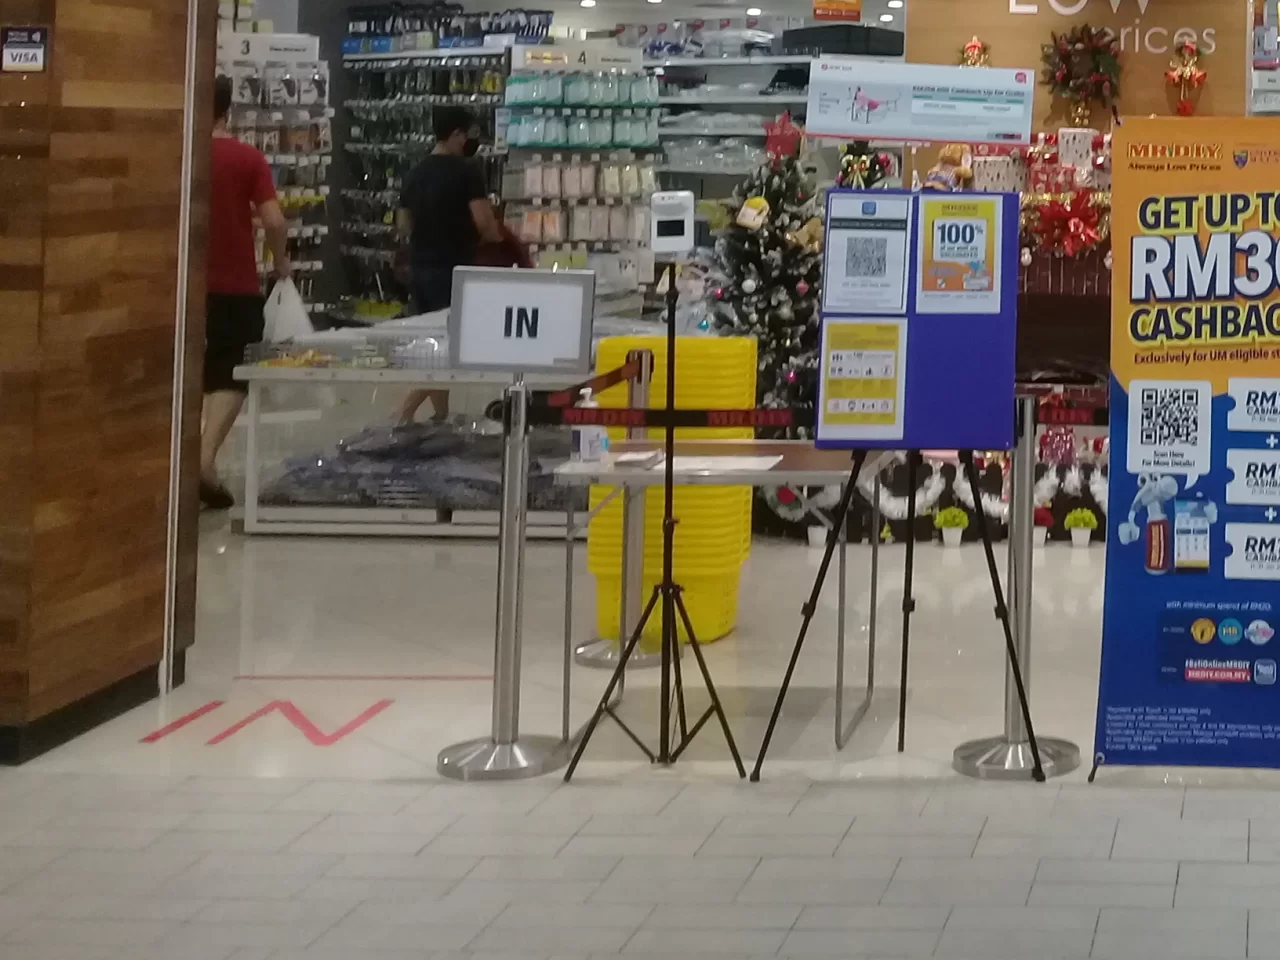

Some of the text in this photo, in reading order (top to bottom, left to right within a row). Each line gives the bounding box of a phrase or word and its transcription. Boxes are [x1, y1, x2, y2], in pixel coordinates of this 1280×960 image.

[240, 40, 251, 55] 3
[10, 51, 38, 64] VISA
[577, 51, 587, 65] 4
[1139, 196, 1198, 229] GET
[1204, 193, 1251, 227] UP
[503, 306, 539, 339] IN
[1134, 350, 1190, 365] Exclusively
[1193, 350, 1207, 361] for
[1209, 349, 1227, 361] UM
[1229, 347, 1269, 362] eligible
[138, 699, 395, 746] IN
